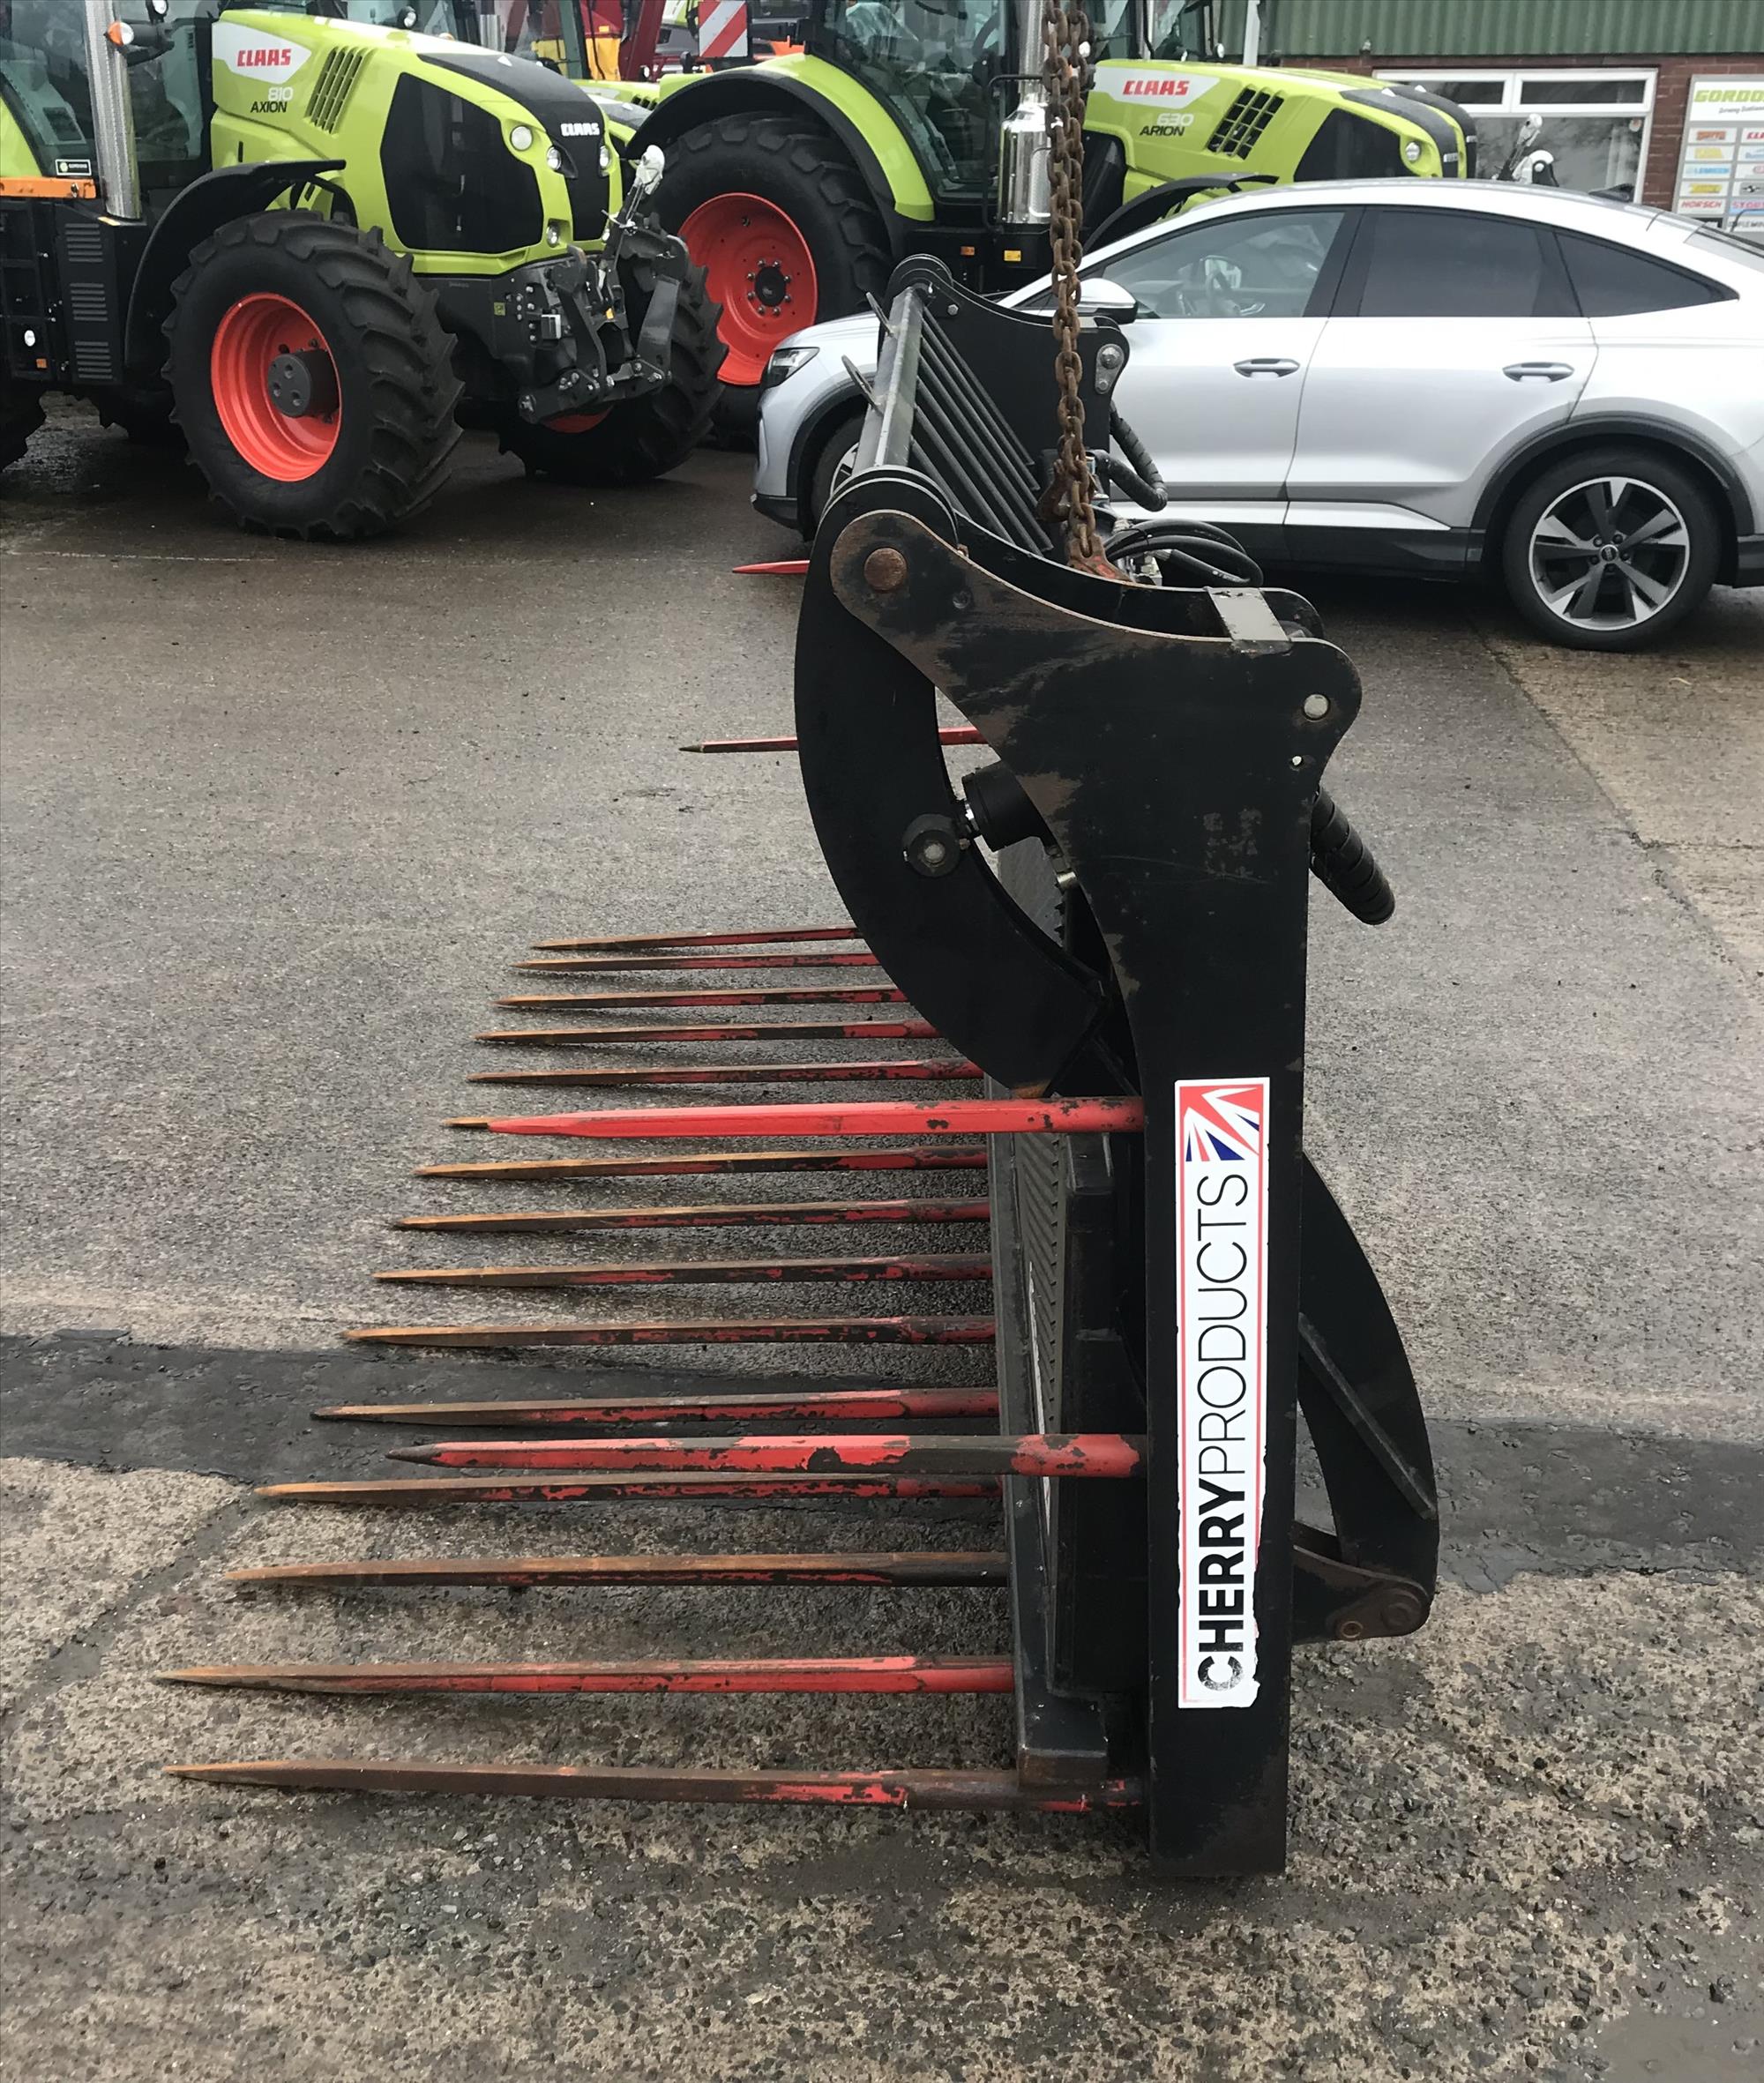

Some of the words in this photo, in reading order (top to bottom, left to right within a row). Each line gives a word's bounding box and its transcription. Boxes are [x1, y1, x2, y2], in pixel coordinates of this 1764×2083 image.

[237, 49, 291, 67] CLAAS
[268, 86, 294, 101] 810
[1123, 80, 1190, 95] CLAAS
[1694, 90, 1764, 102] GORDO
[250, 101, 288, 113] AXION
[1156, 113, 1194, 127] 630
[560, 123, 600, 137] CLAAS
[1139, 125, 1185, 136] ARION
